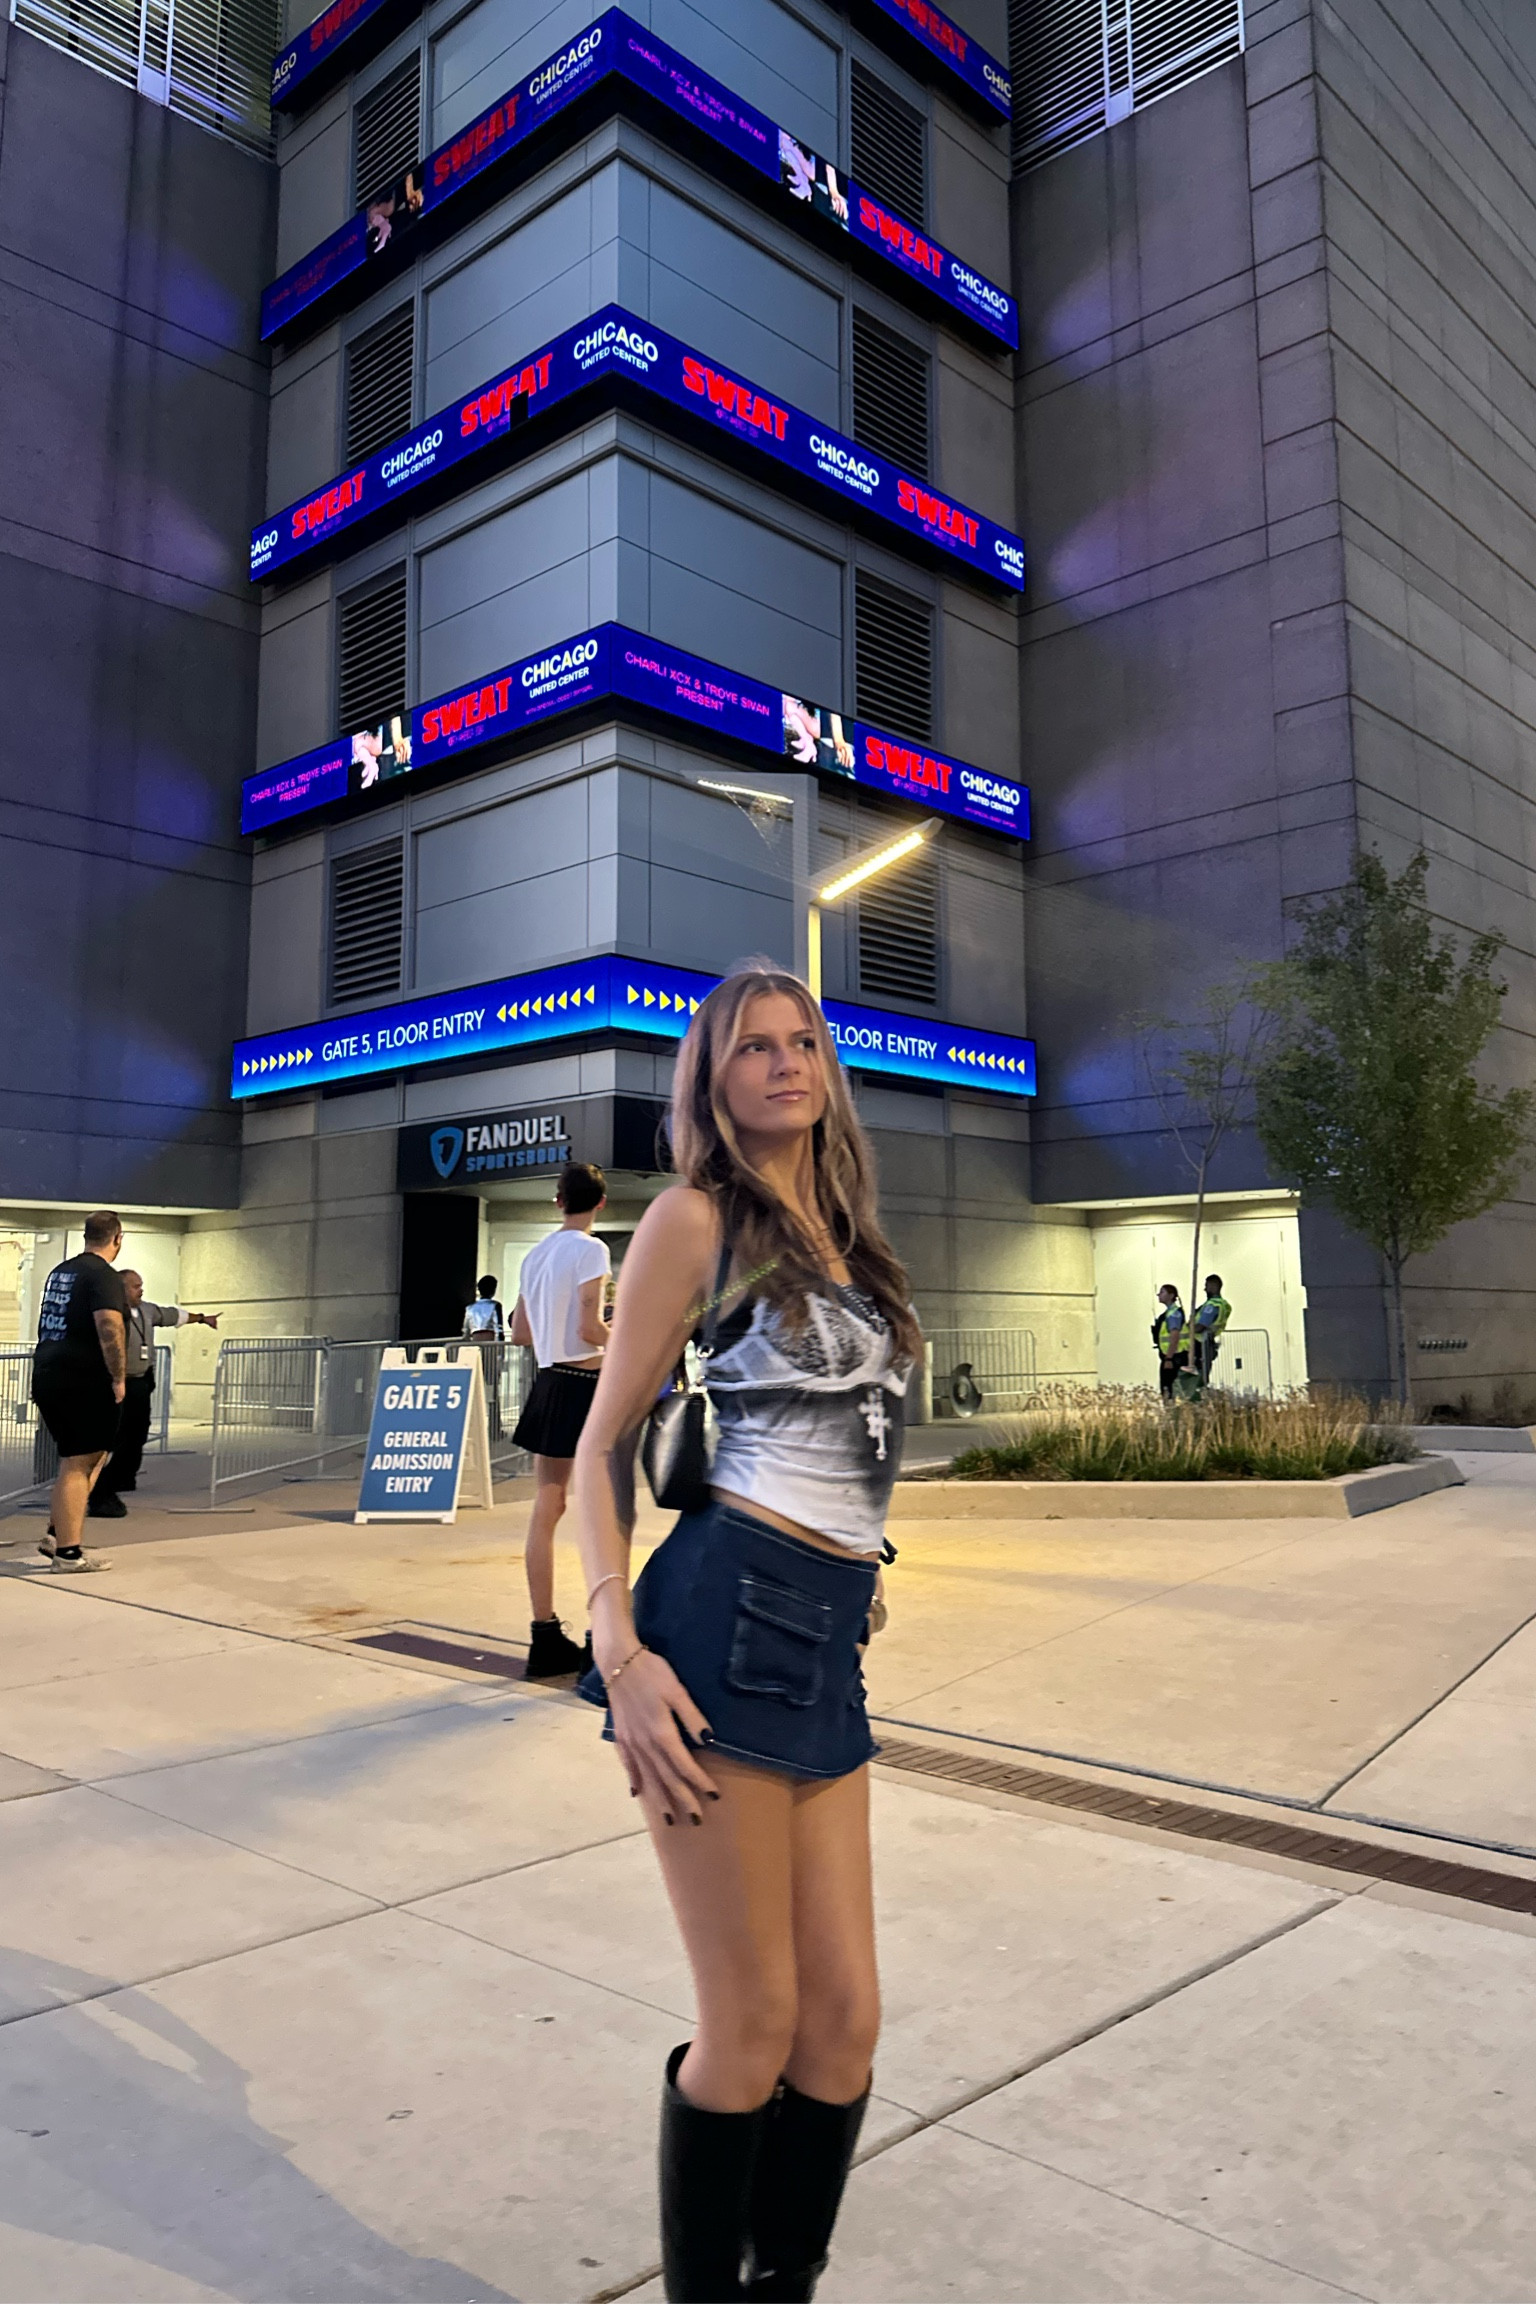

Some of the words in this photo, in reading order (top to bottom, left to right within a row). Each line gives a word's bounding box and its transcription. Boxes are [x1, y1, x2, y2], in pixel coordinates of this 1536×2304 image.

[528, 28, 602, 97] CHICAGO
[536, 79, 563, 105] UNITED
[563, 54, 594, 83] CENTER
[433, 93, 520, 187] SWEAT
[859, 197, 944, 278] SWEAT
[951, 262, 1009, 314] CHICAGO
[957, 284, 980, 305] UNITED
[979, 301, 1004, 322] CENTER
[573, 321, 659, 363] CHICAGO
[581, 346, 610, 370] UNITED
[612, 345, 649, 373] CENTER
[683, 356, 789, 441] SWEAT
[381, 429, 443, 479] CHICAGO
[387, 468, 410, 488] UNITED
[410, 453, 436, 475] CENTER
[809, 435, 880, 487] CHICAGO
[817, 459, 844, 480] UNITED
[844, 473, 872, 496] CENTER
[291, 470, 366, 539] SWEAT
[897, 479, 980, 548] SWEAT
[251, 550, 272, 569] CENTER
[1001, 561, 1023, 578] UNITED
[521, 638, 598, 687] CHICAGO
[529, 680, 558, 699] UNITED
[557, 666, 589, 687] CENTER
[624, 651, 667, 677] CHARLI
[669, 668, 691, 686] XCX
[693, 678, 701, 690] &
[704, 681, 738, 705] TROYE
[740, 697, 770, 717] SIVAN
[676, 685, 725, 712] PRESENT
[422, 676, 513, 745] SWEAT
[865, 736, 952, 794] SWEAT
[279, 782, 311, 803] PRESENT
[960, 770, 1020, 806] CHICAGO
[967, 791, 990, 808] UNITED
[989, 800, 1014, 816] CENTER
[322, 1035, 359, 1062] GATE
[361, 1033, 374, 1056] 5,
[377, 1021, 429, 1051] FLOOR
[432, 1008, 486, 1039] ENTRY
[887, 1033, 938, 1060] ENTRY
[466, 1114, 569, 1152] FANDUEL
[466, 1145, 570, 1172] SPORTSBOOK
[383, 1384, 441, 1410] GATE
[446, 1385, 462, 1409] 5
[383, 1431, 448, 1448] GENERAL
[370, 1453, 454, 1471] ADMISSION
[385, 1476, 434, 1493] ENTRY
